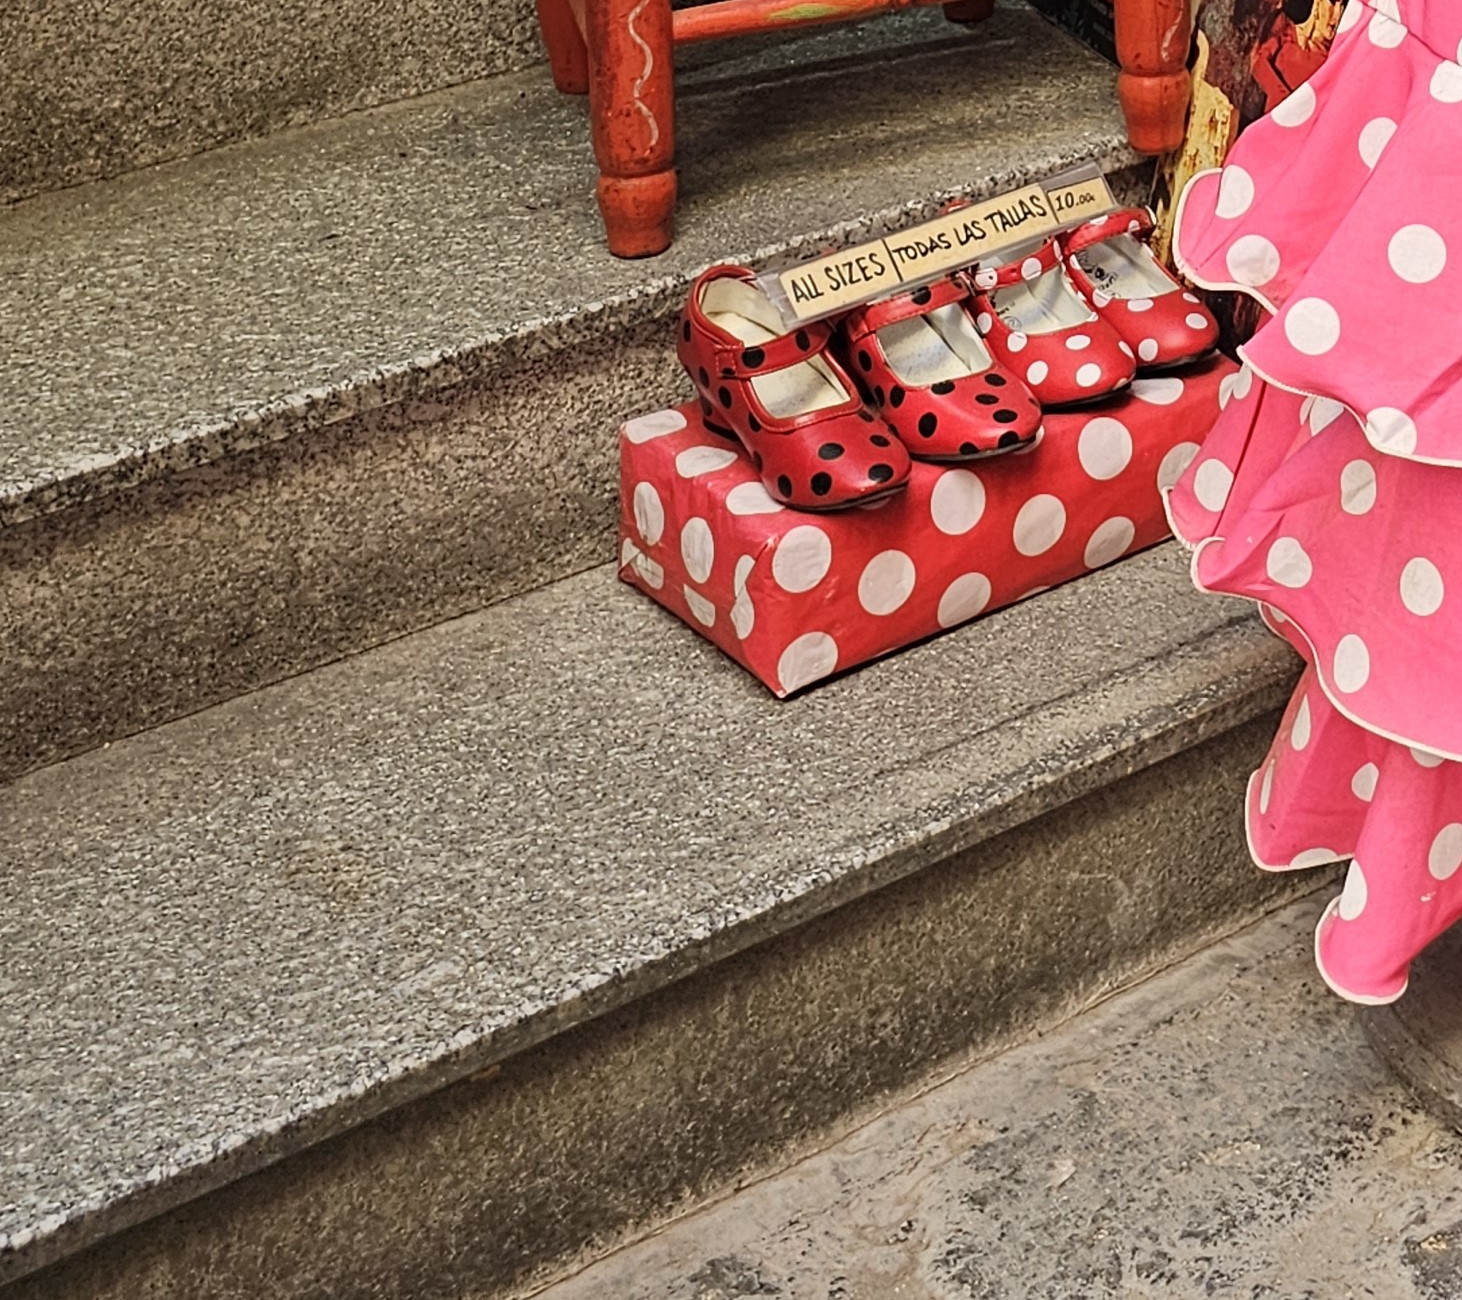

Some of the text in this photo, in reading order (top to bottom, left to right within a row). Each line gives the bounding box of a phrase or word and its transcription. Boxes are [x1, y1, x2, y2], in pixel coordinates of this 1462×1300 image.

[790, 273, 824, 304] ALL
[824, 252, 886, 292] SIZES
[892, 232, 953, 265] TODAS
[953, 220, 987, 247] LAS
[985, 193, 1047, 234] TALLAS
